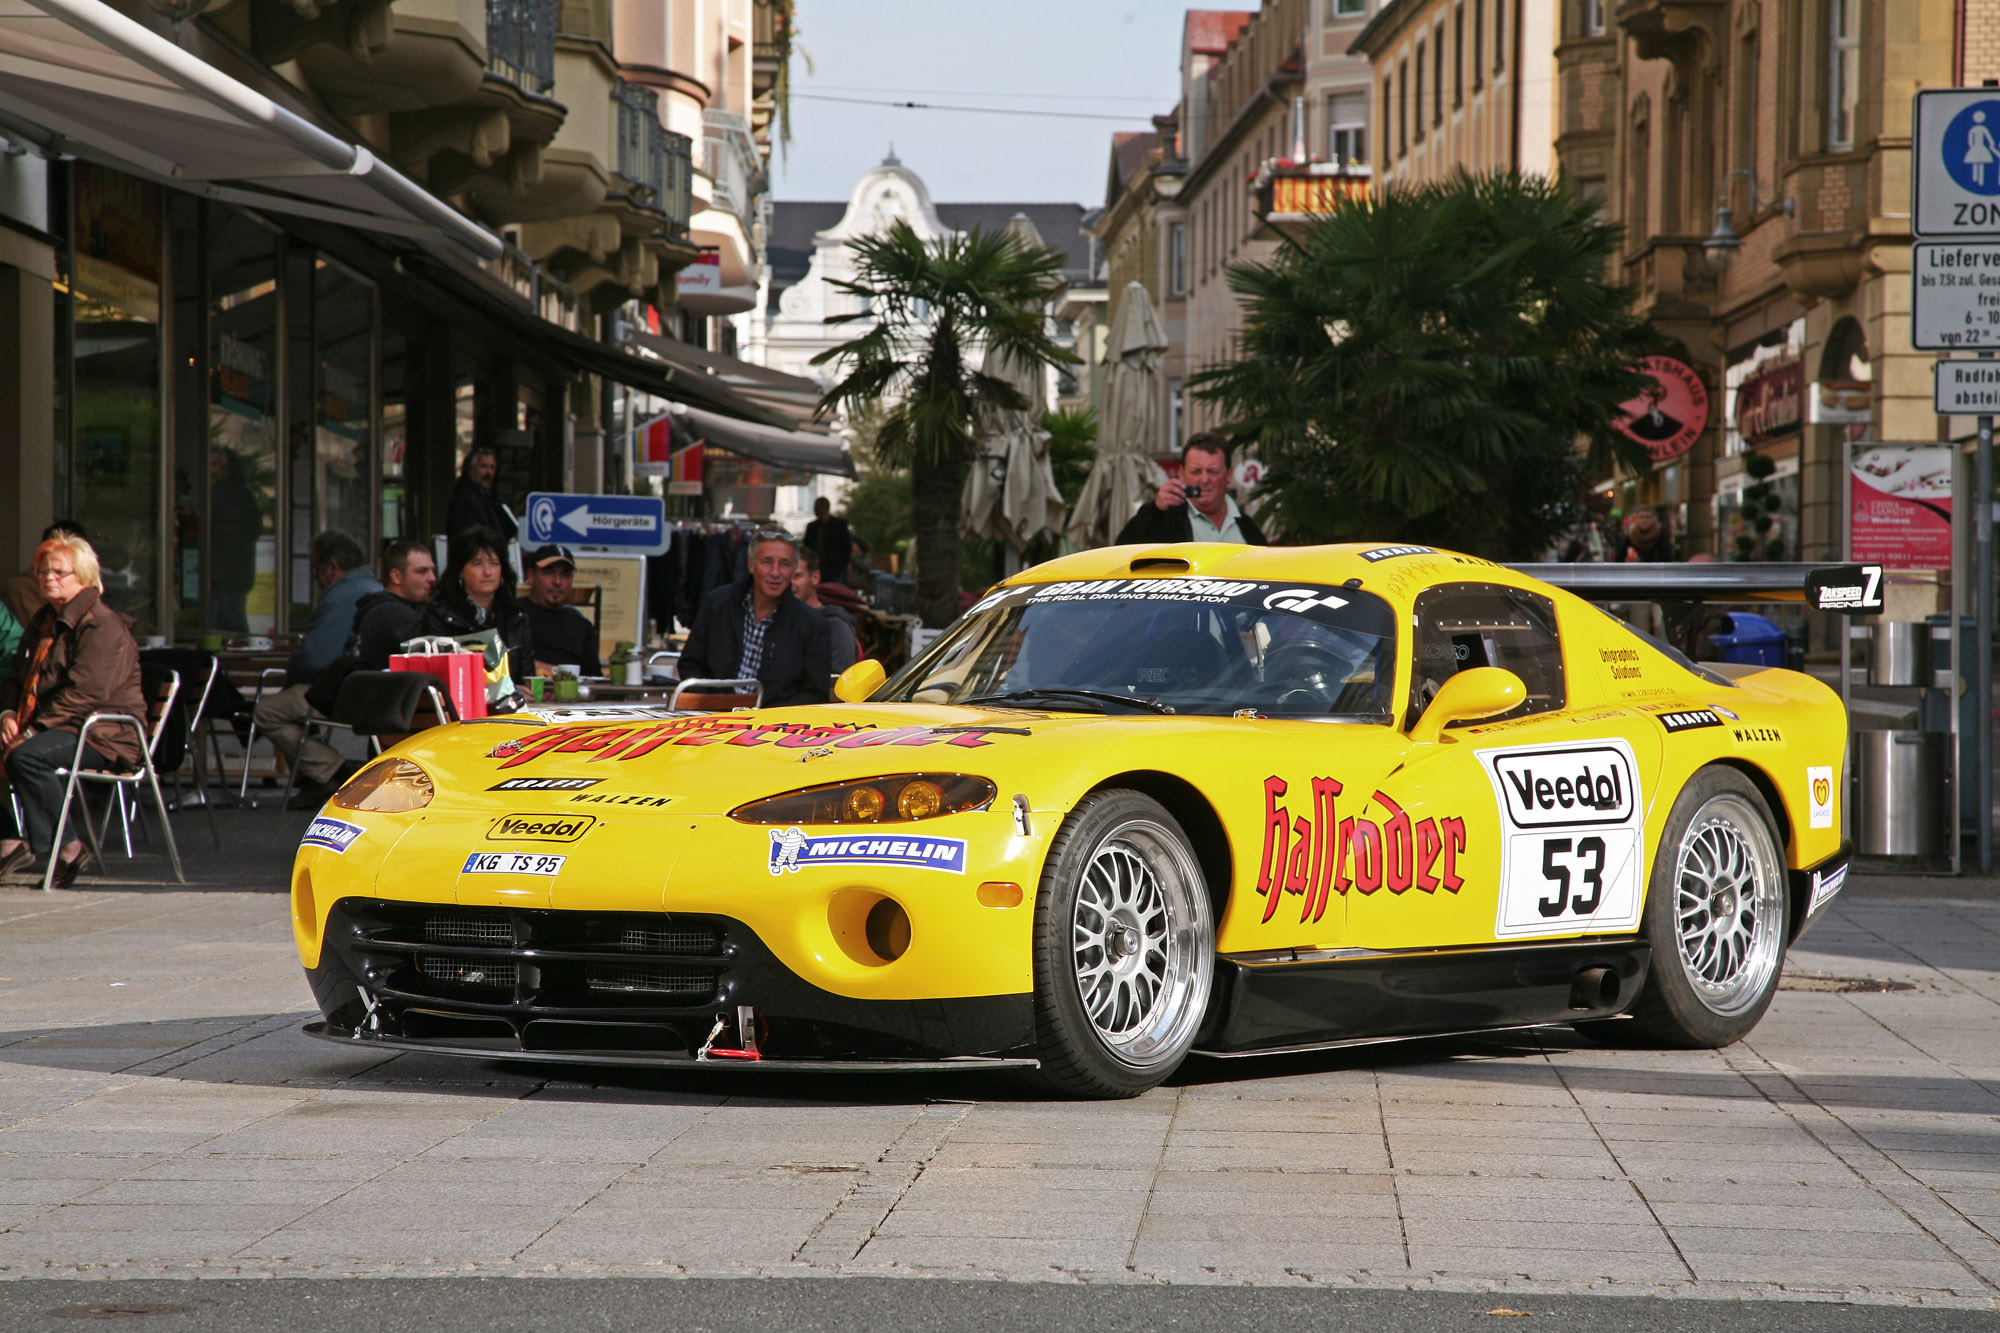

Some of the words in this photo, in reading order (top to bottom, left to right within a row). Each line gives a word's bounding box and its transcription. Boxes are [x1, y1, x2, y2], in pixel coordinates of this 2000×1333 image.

[1921, 273, 1937, 287] bis
[1940, 332, 1962, 344] von
[1955, 390, 2000, 405] abstei
[591, 515, 650, 527] Hörgeräte
[1450, 556, 1512, 570] WALZ
[1034, 580, 1127, 597] GRAN
[1819, 586, 1863, 602] ZAKSPEED
[1025, 597, 1049, 605] THE
[1051, 594, 1087, 602] REAL
[1088, 592, 1146, 601] DRIVING
[1147, 593, 1231, 604] SIMULATOR
[1819, 601, 1863, 609] RACING
[1598, 648, 1640, 664] Unigraphics
[1610, 665, 1642, 680] Solutions
[1663, 711, 1718, 728] KRAFFT
[1732, 728, 1782, 742] WALZEN
[500, 779, 598, 789] KRAFFT
[1505, 764, 1623, 811] Veedol
[569, 793, 673, 807] WALZEN
[498, 819, 586, 837] Veedol
[808, 841, 958, 861] MICHELIN
[475, 855, 503, 871] KG
[510, 855, 534, 871] TS
[536, 856, 561, 873] 95
[1538, 836, 1606, 918] 53
